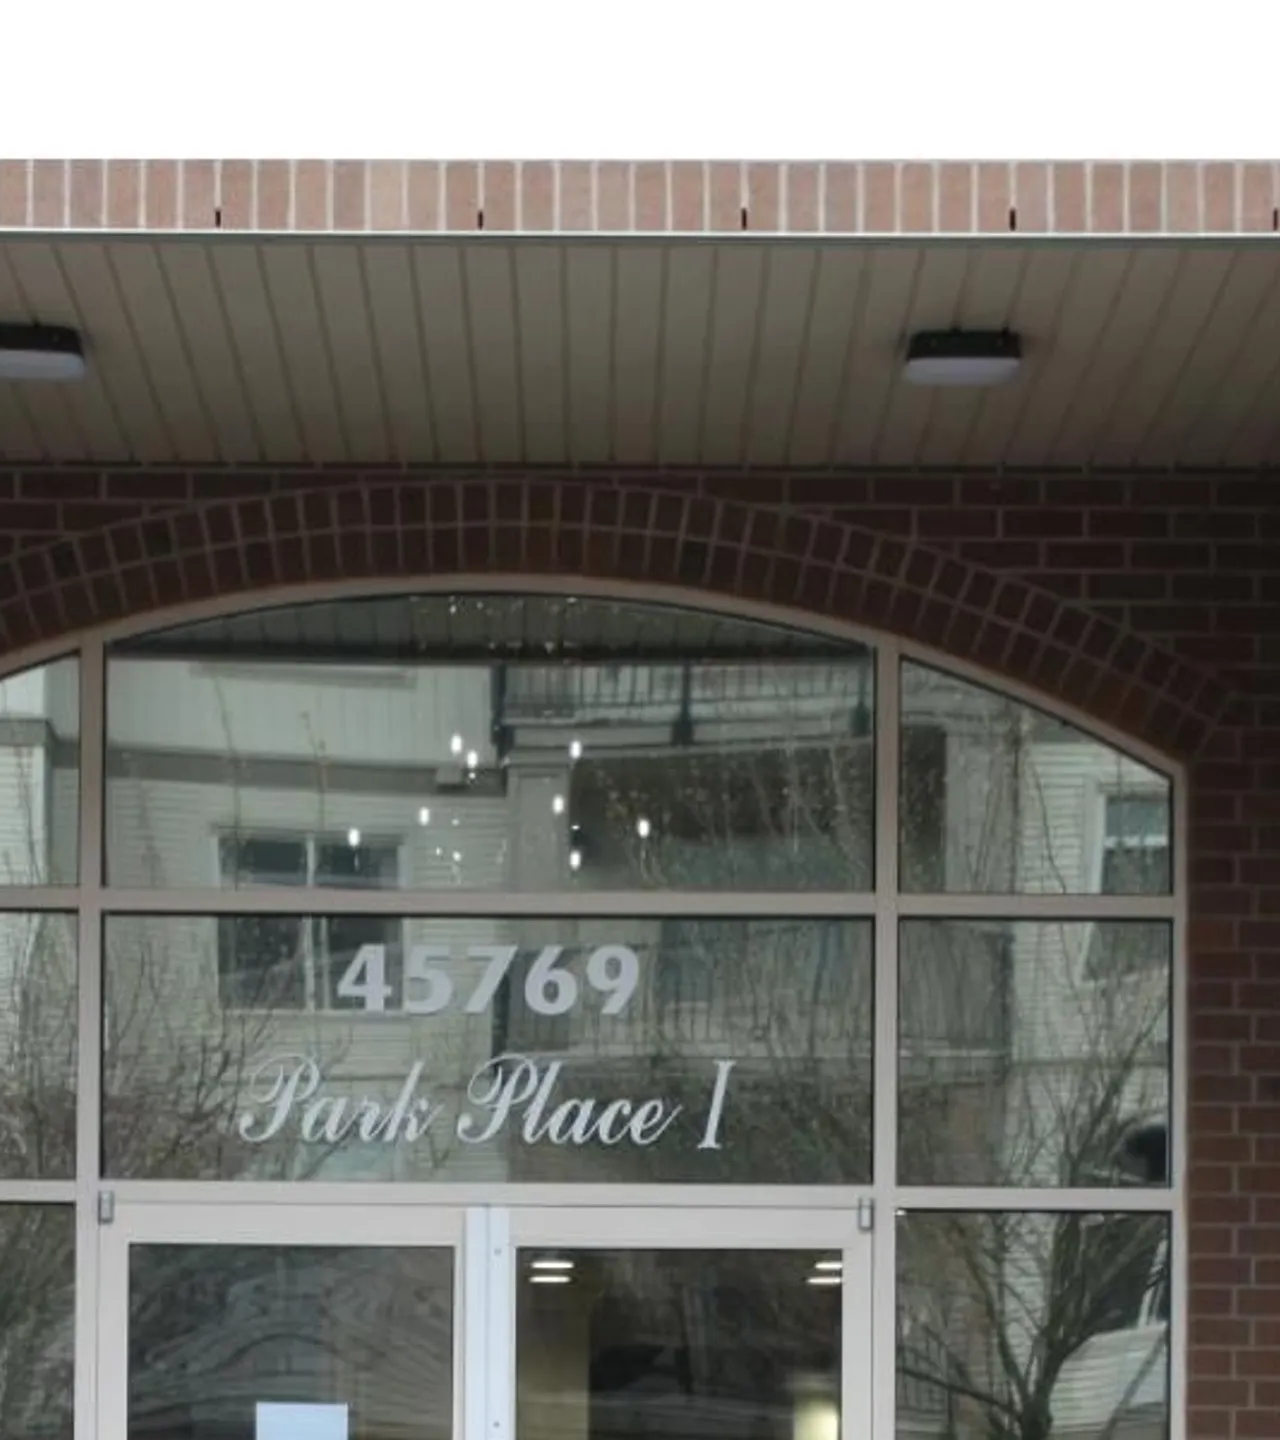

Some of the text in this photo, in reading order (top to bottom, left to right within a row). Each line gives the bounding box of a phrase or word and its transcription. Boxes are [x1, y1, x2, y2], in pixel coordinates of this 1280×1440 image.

[337, 944, 639, 1014] 45769
[239, 1055, 445, 1144] Park
[457, 1053, 682, 1146] Place
